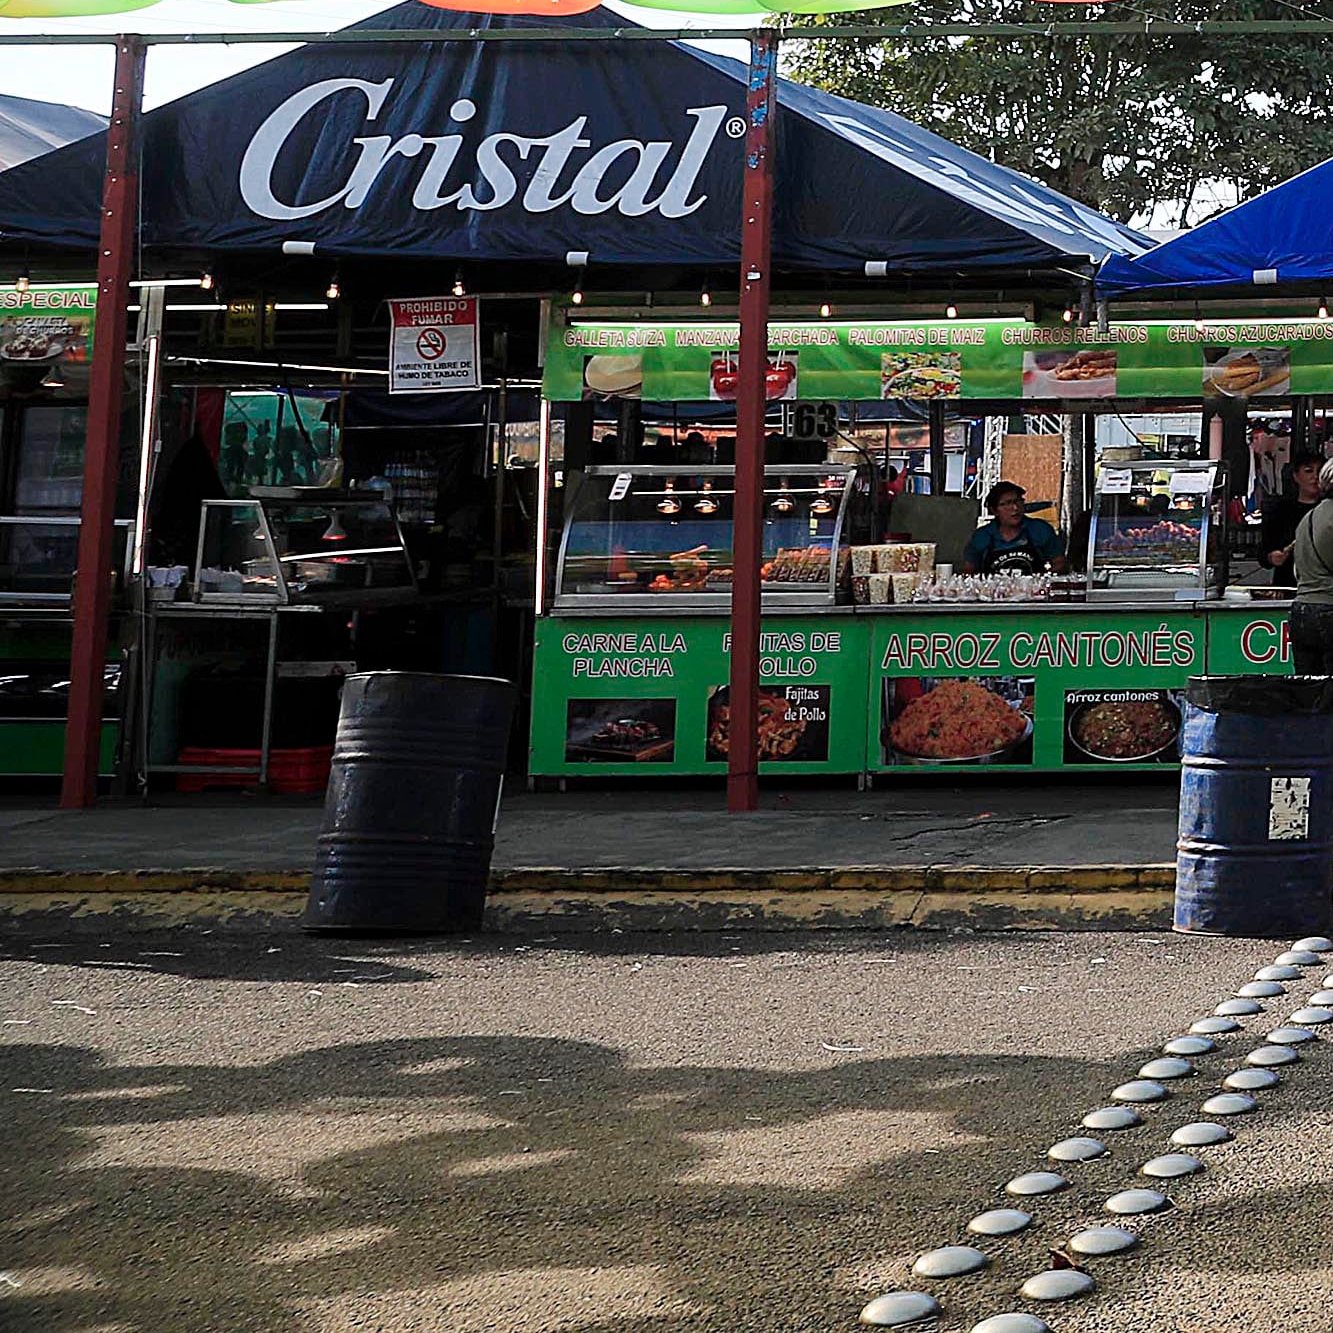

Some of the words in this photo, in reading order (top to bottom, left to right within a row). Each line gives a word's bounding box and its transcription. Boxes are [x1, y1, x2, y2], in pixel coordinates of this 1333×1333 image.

[239, 77, 728, 220] Cristal
[399, 300, 468, 314] PROHIBIDO
[411, 313, 454, 325] FUMAR
[564, 329, 624, 347] GALLETA
[626, 328, 666, 347] SUIZA
[675, 329, 740, 347] MANZANA
[848, 328, 928, 346] PALOMITAS
[929, 328, 949, 345] DE
[951, 327, 987, 345] MAIZ
[1001, 327, 1072, 345] CHURROS
[1074, 326, 1149, 345] RELLENOS
[1166, 324, 1237, 344] CHURROS
[396, 362, 432, 370] AMBIENTE
[433, 361, 457, 370] LIBRE
[460, 361, 473, 369] DE
[398, 371, 420, 379] HUMO
[421, 371, 433, 379] DE
[434, 369, 469, 378] TABACO
[794, 403, 838, 439] 63
[562, 633, 637, 654] CARNE
[640, 633, 660, 653] A
[660, 632, 688, 653] LA
[722, 632, 807, 654] FITAS
[810, 632, 841, 652] DE
[881, 631, 1002, 669] ARROZ
[1008, 623, 1195, 668] CANTONÉS
[572, 657, 675, 678] PLANCHA
[758, 657, 818, 677] OLLO
[784, 685, 820, 705] Fajitas
[1066, 691, 1102, 704] Arroz
[1102, 690, 1160, 703] cantones
[784, 707, 798, 721] de
[799, 706, 826, 722] Pollo
